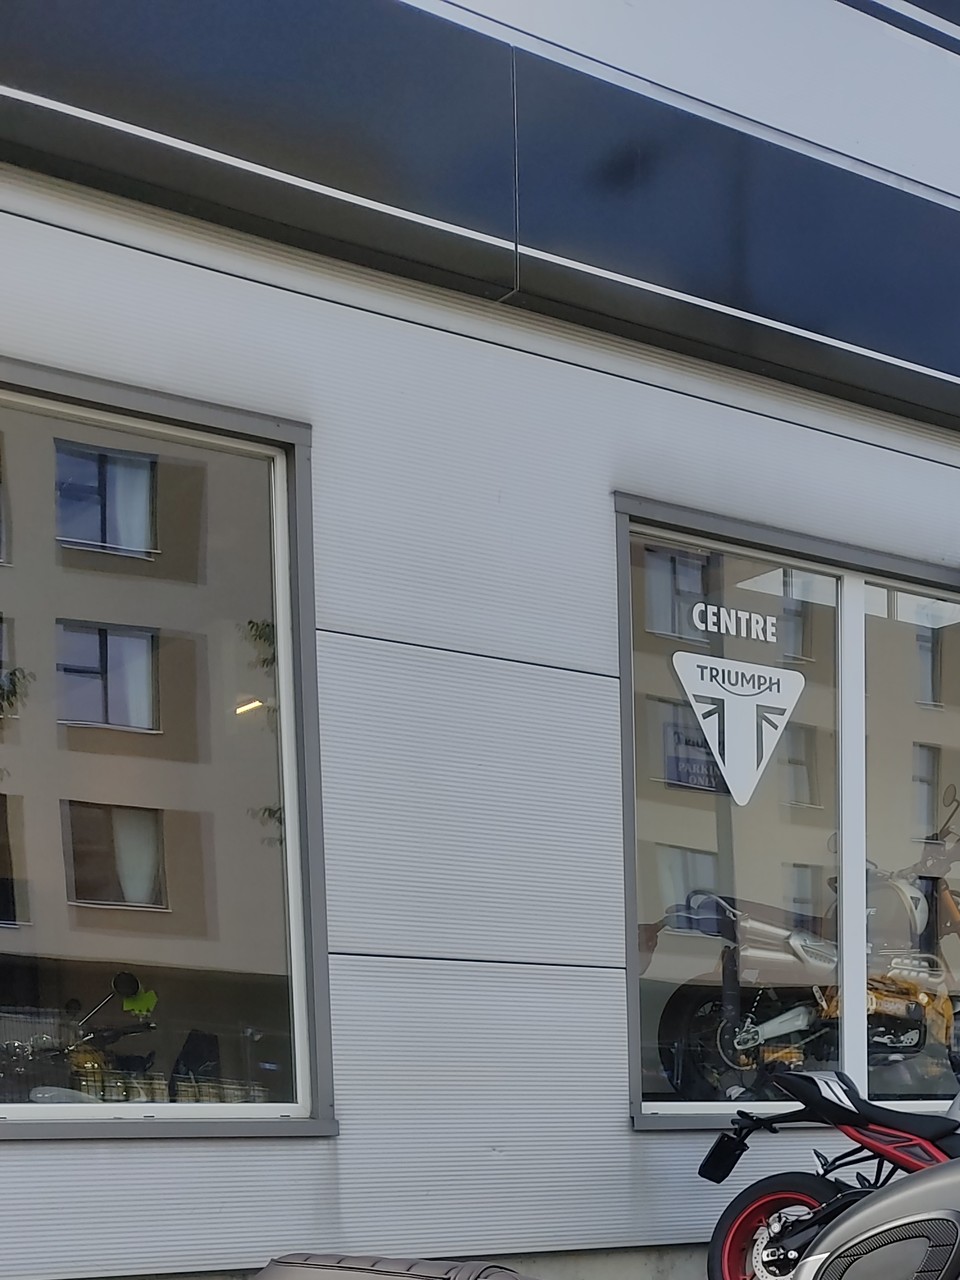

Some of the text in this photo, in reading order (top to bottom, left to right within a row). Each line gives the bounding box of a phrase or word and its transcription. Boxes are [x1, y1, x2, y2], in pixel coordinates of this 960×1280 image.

[692, 602, 777, 643] CENTRE
[696, 664, 781, 696] TRIUMPH
[678, 762, 720, 776] PARKIN
[688, 775, 717, 787] ONLY
